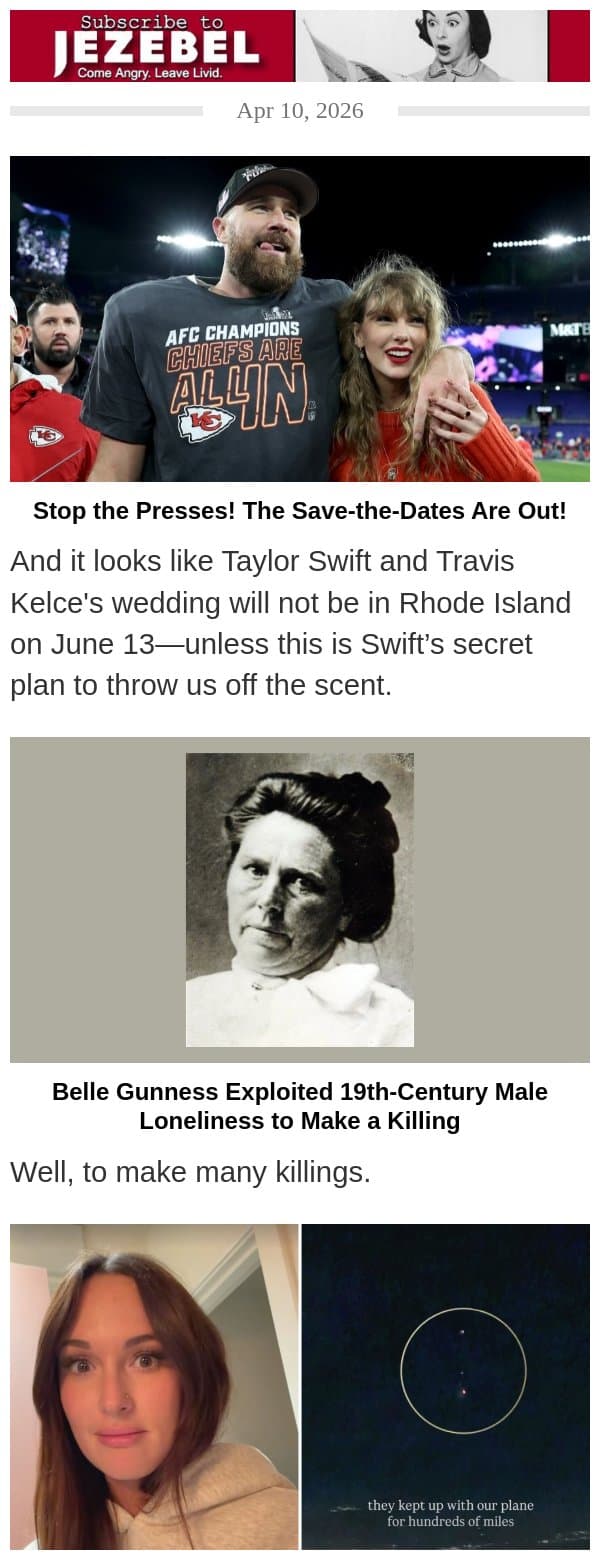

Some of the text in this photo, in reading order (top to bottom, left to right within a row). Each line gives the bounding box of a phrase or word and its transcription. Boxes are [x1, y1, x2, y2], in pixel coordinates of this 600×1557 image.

[81, 15, 223, 29] Subscribe to
[53, 30, 260, 79] JEZEBEL
[77, 67, 223, 81] Come Angry. Leave Livid.
[237, 102, 364, 124] Apr 10, 2026
[165, 321, 300, 347] AFC CHAMPIONS
[166, 337, 303, 373] CHIEFS ARE
[170, 363, 307, 430] ALL IN
[34, 501, 566, 524] Stop the Presses! The Save-the-Dates Are Out!
[140, 1109, 460, 1136] Loneliness to Make a Killing
